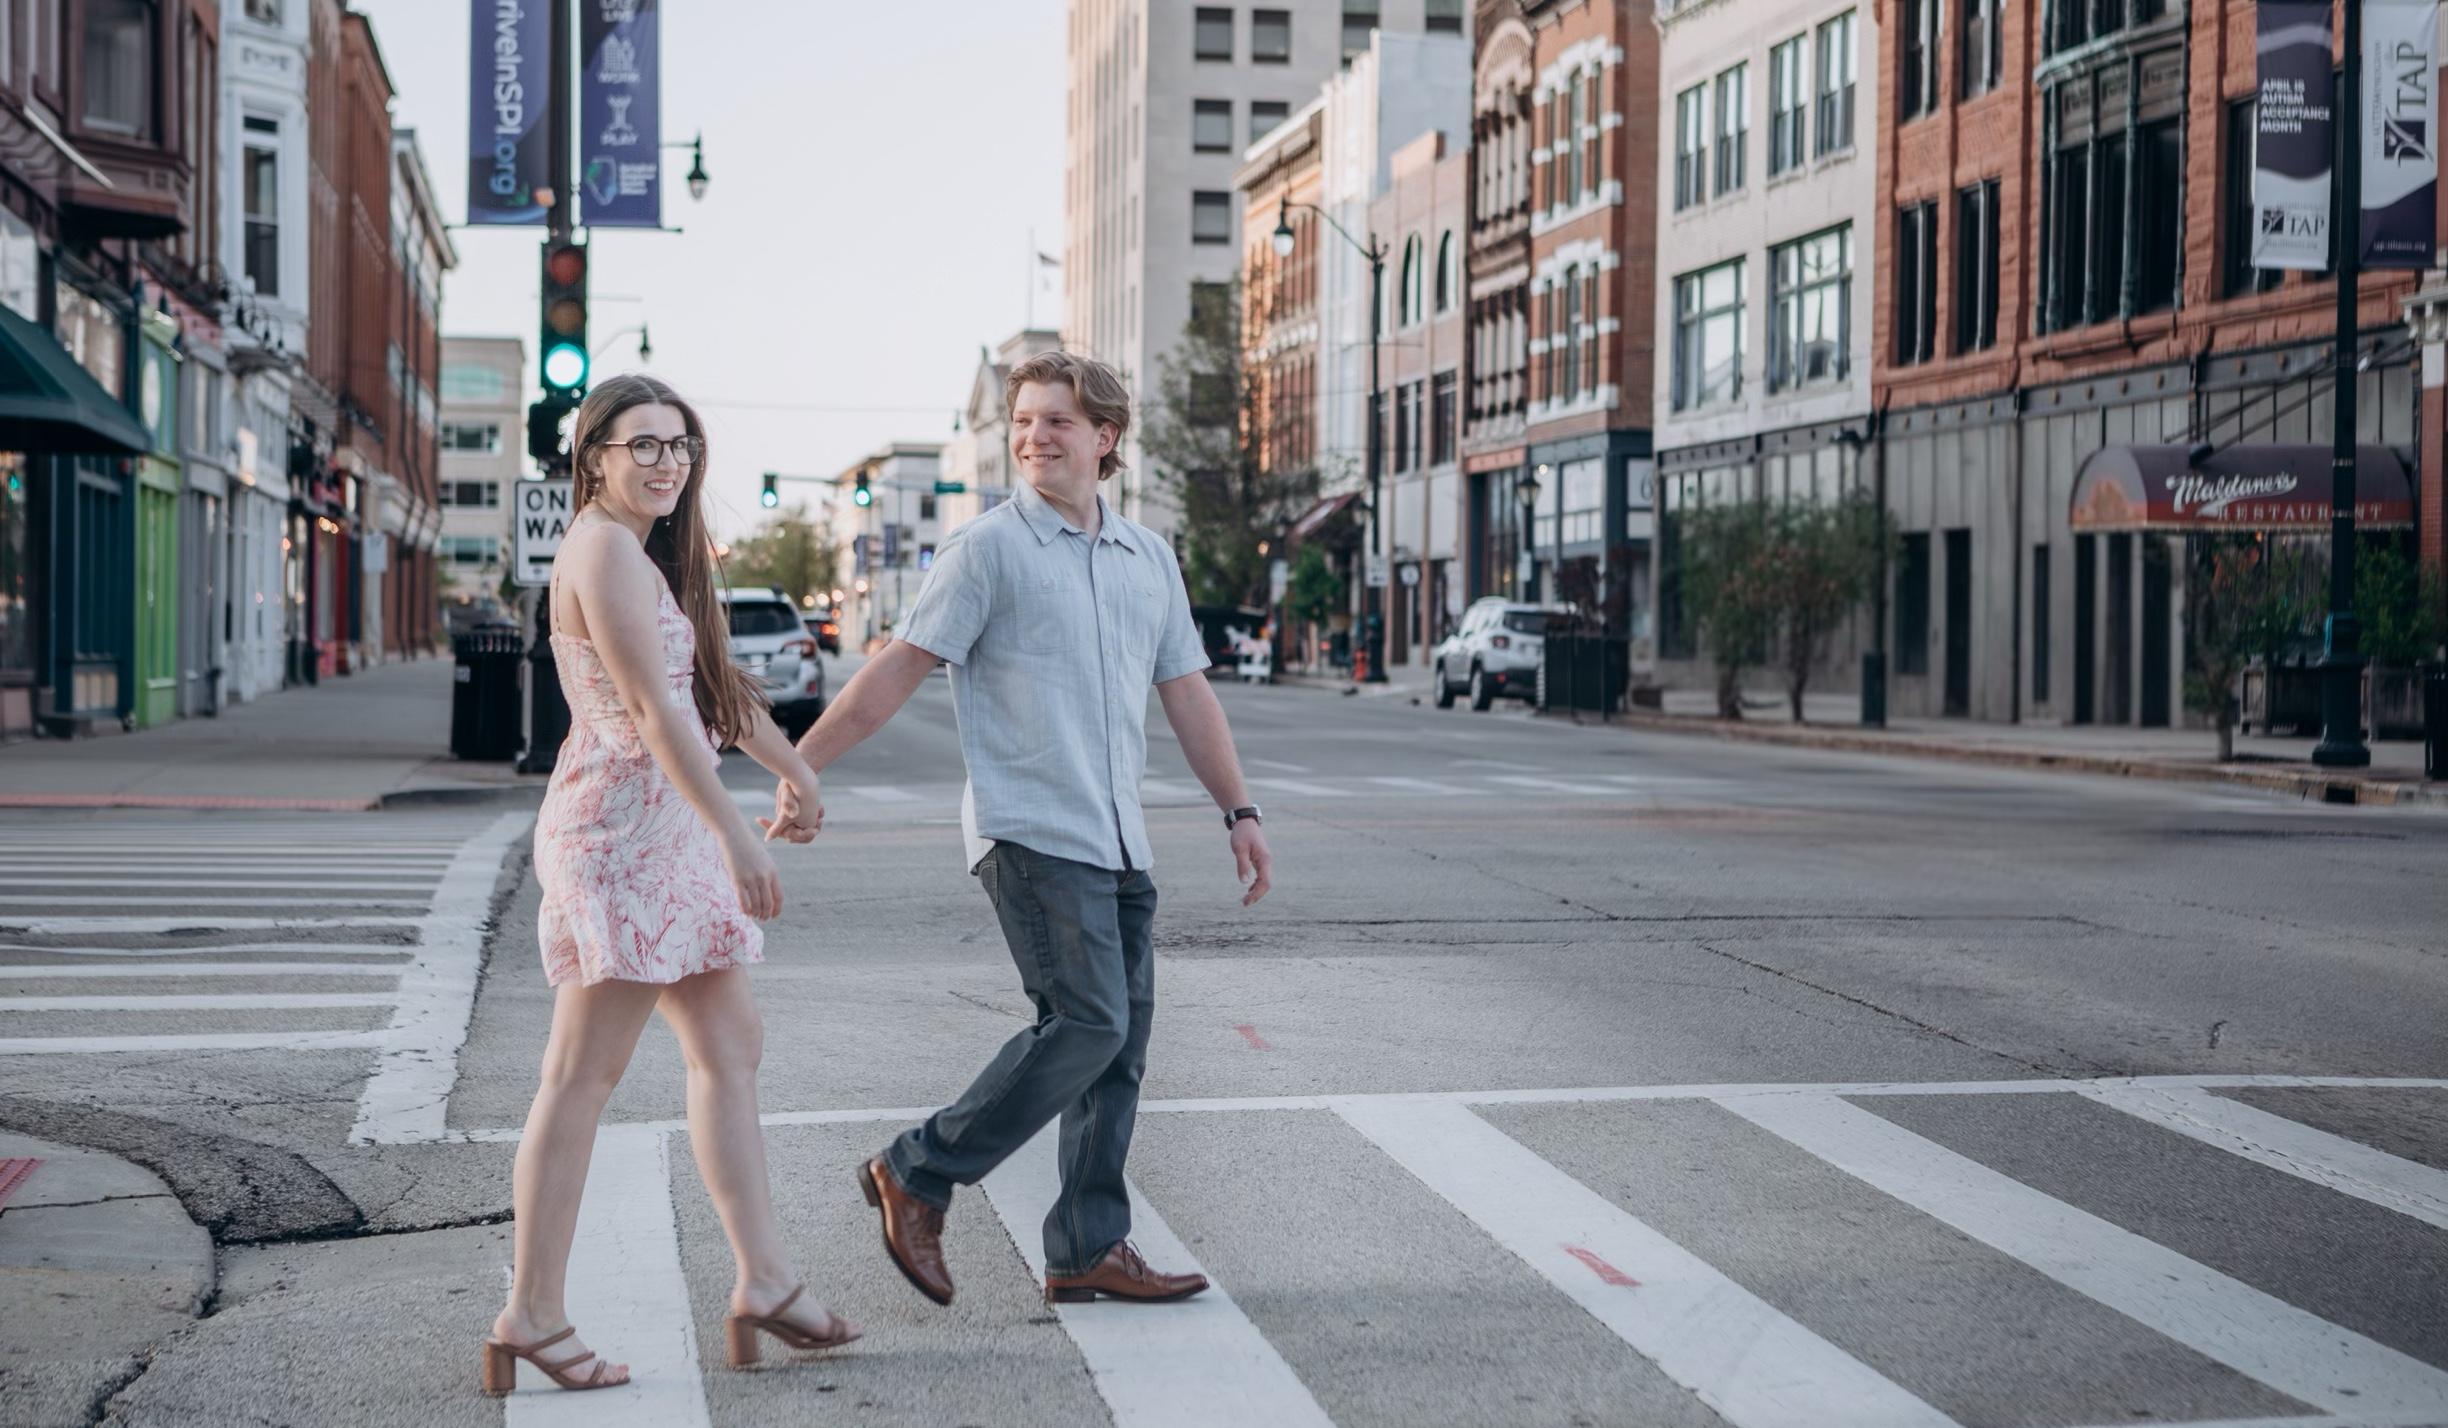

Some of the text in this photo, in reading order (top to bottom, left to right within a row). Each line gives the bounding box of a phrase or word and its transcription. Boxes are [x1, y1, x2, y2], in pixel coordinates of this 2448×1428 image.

[2262, 79, 2305, 93] APRIL IS
[2396, 40, 2427, 117] TAP
[2261, 92, 2304, 105] AUTISM
[2261, 105, 2330, 120] ACCEPTANCE
[2261, 119, 2302, 133] MONTH
[2288, 214, 2325, 236] TAP
[526, 489, 568, 512] ON
[2217, 503, 2382, 521] RESTAURNT
[525, 517, 565, 539] WA
